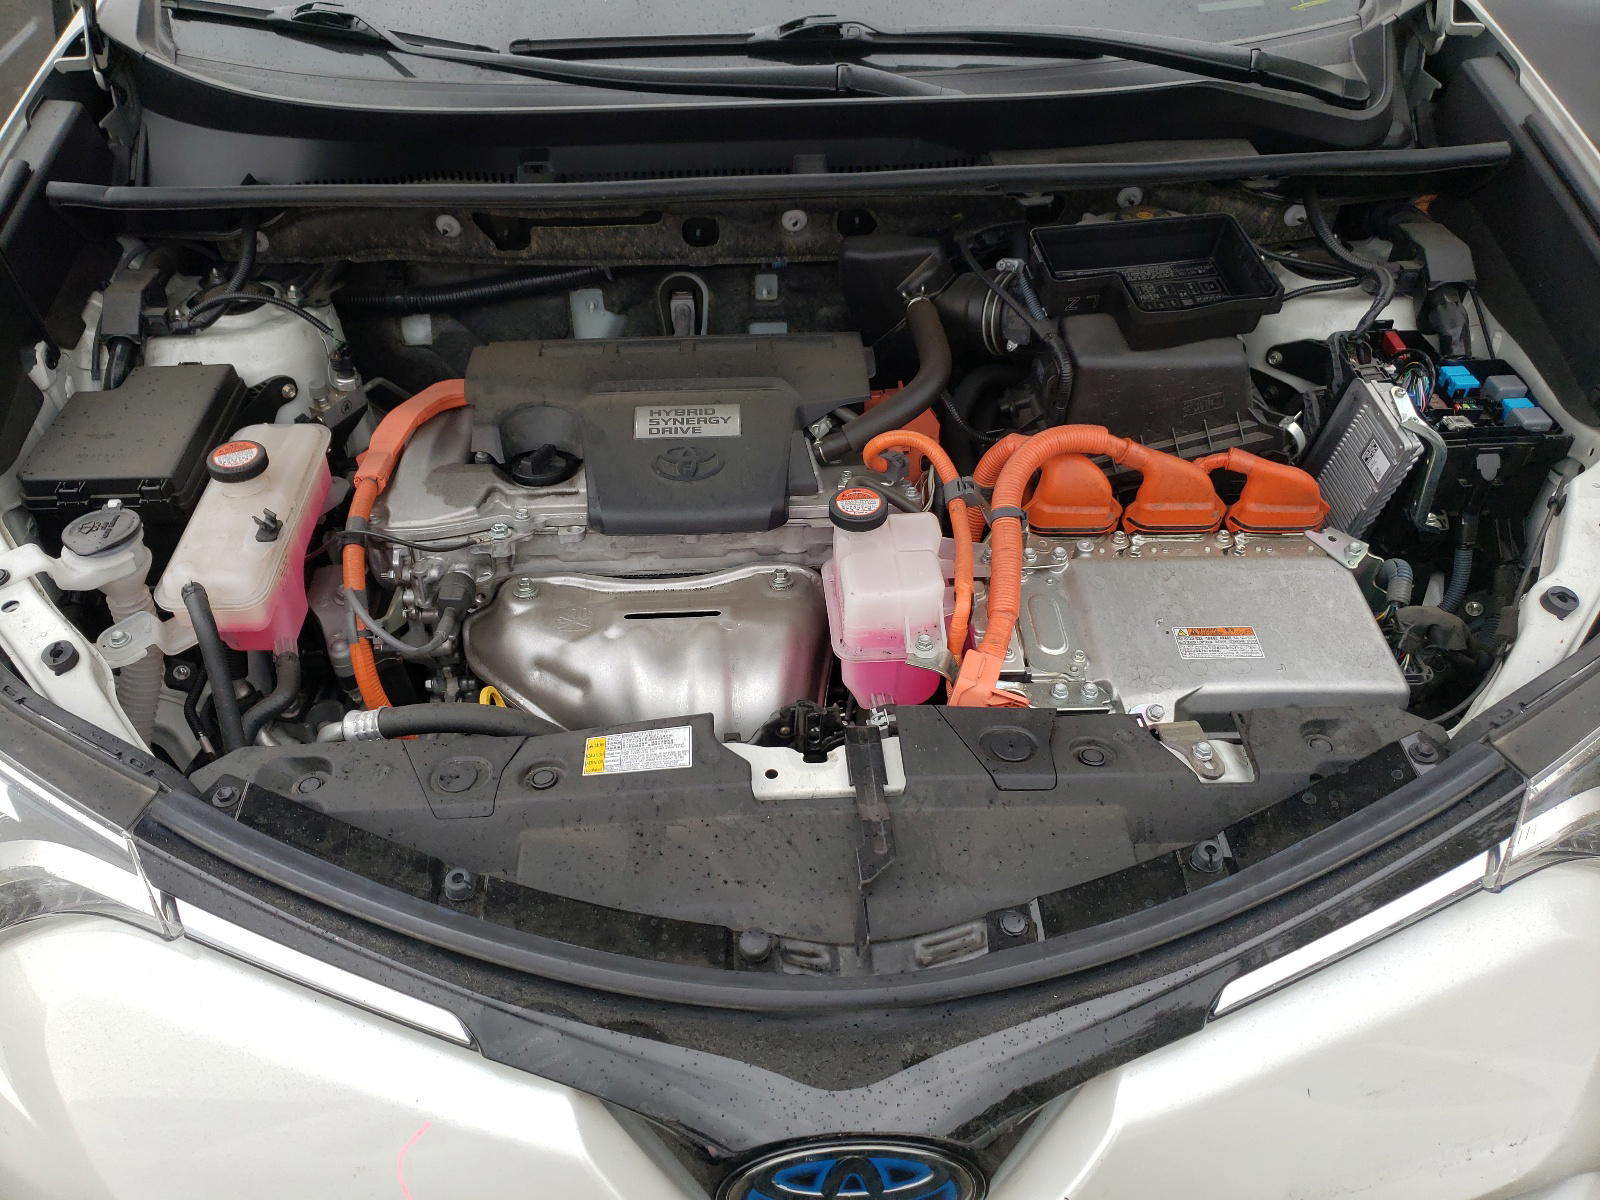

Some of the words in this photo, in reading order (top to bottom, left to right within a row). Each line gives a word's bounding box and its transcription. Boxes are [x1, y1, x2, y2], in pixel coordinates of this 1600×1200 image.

[650, 407, 716, 417] HYBRID
[649, 416, 732, 426] SYNERGY
[649, 426, 702, 435] DRIVE
